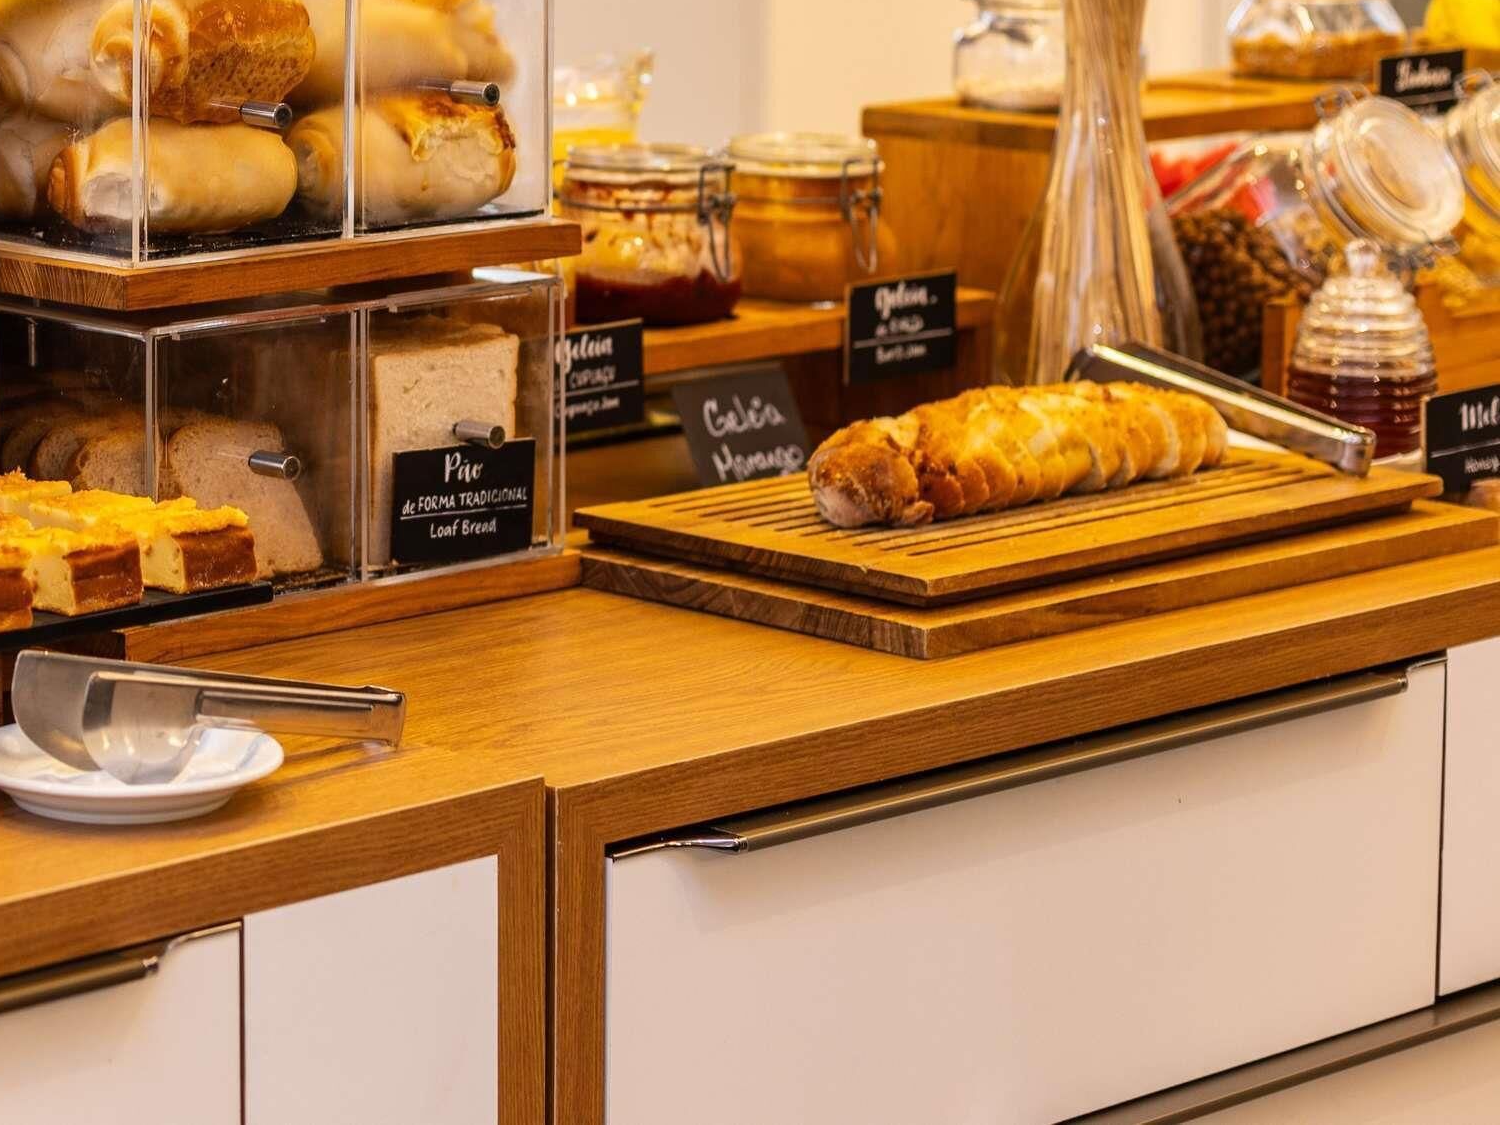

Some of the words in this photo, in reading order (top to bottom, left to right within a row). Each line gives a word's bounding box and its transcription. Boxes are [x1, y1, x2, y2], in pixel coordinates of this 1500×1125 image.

[402, 500, 415, 515] de
[418, 494, 456, 512] FORMA
[459, 486, 528, 507] TRADICIONAL
[430, 518, 459, 539] Loaf
[462, 517, 497, 535] Bread
